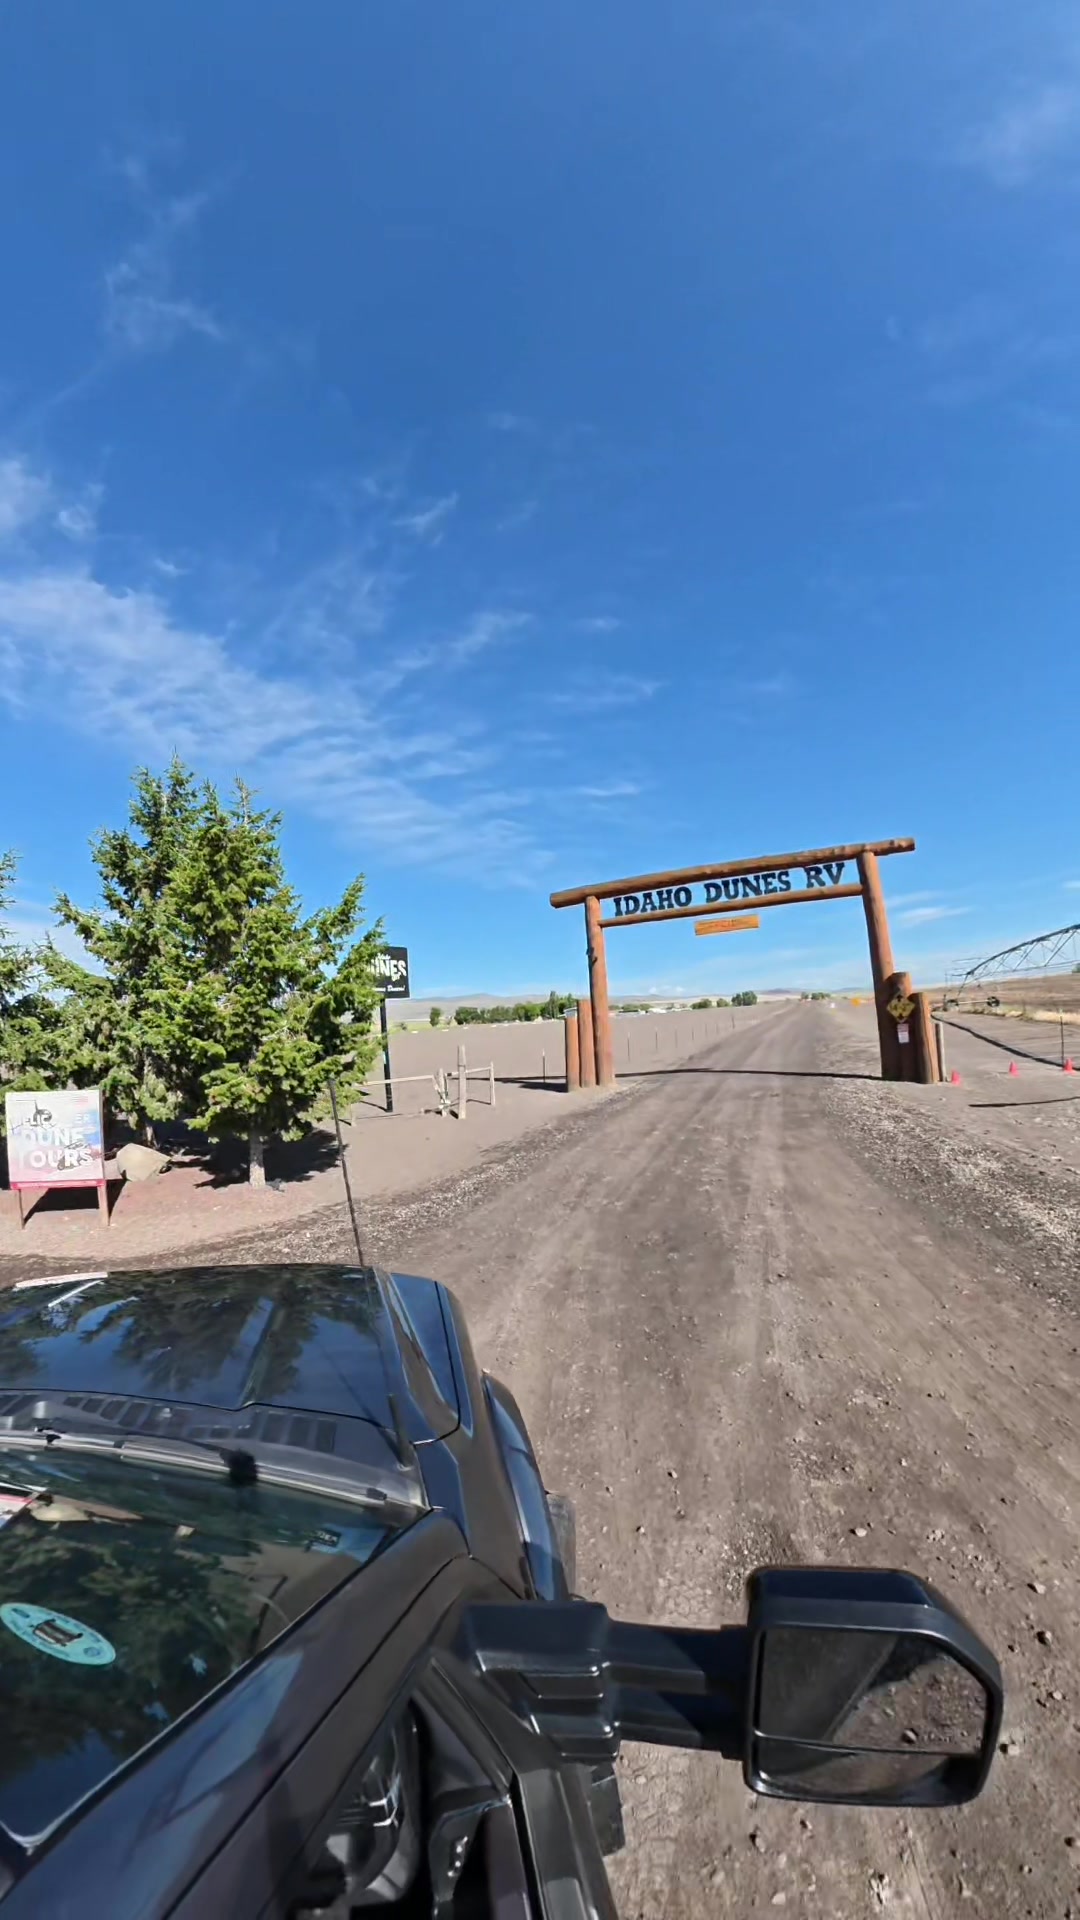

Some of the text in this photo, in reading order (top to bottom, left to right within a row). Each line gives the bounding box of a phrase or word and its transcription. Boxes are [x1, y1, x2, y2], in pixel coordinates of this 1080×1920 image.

[613, 862, 845, 917] IDAHO DUNES RV
